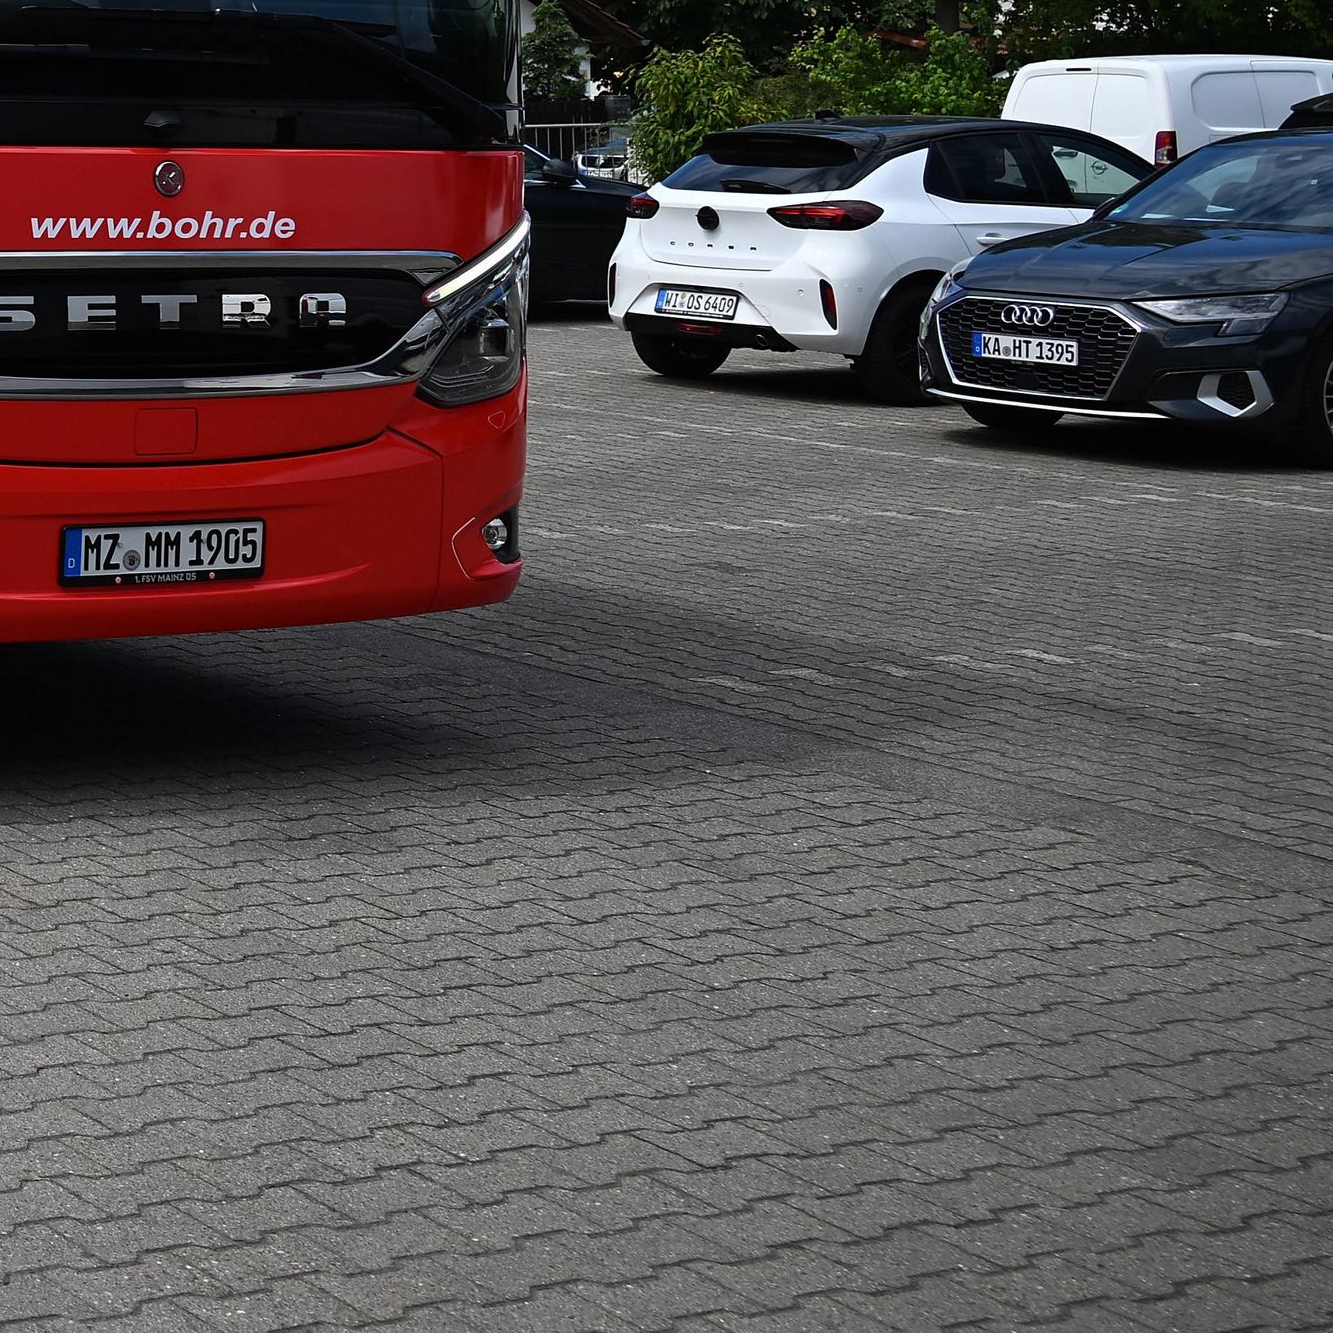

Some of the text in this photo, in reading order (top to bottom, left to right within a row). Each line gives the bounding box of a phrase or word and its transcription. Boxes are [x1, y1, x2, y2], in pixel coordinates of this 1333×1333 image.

[30, 210, 296, 239] www.bohr.de
[665, 292, 679, 308] WI
[687, 294, 703, 310] OS
[704, 296, 734, 313] 6409
[983, 335, 1074, 363] KA HT 1395
[84, 527, 258, 571] MZ MM 1905
[67, 557, 76, 569] D
[141, 574, 156, 583] FSV
[158, 573, 184, 583] MAINZ
[186, 573, 197, 581] 05
